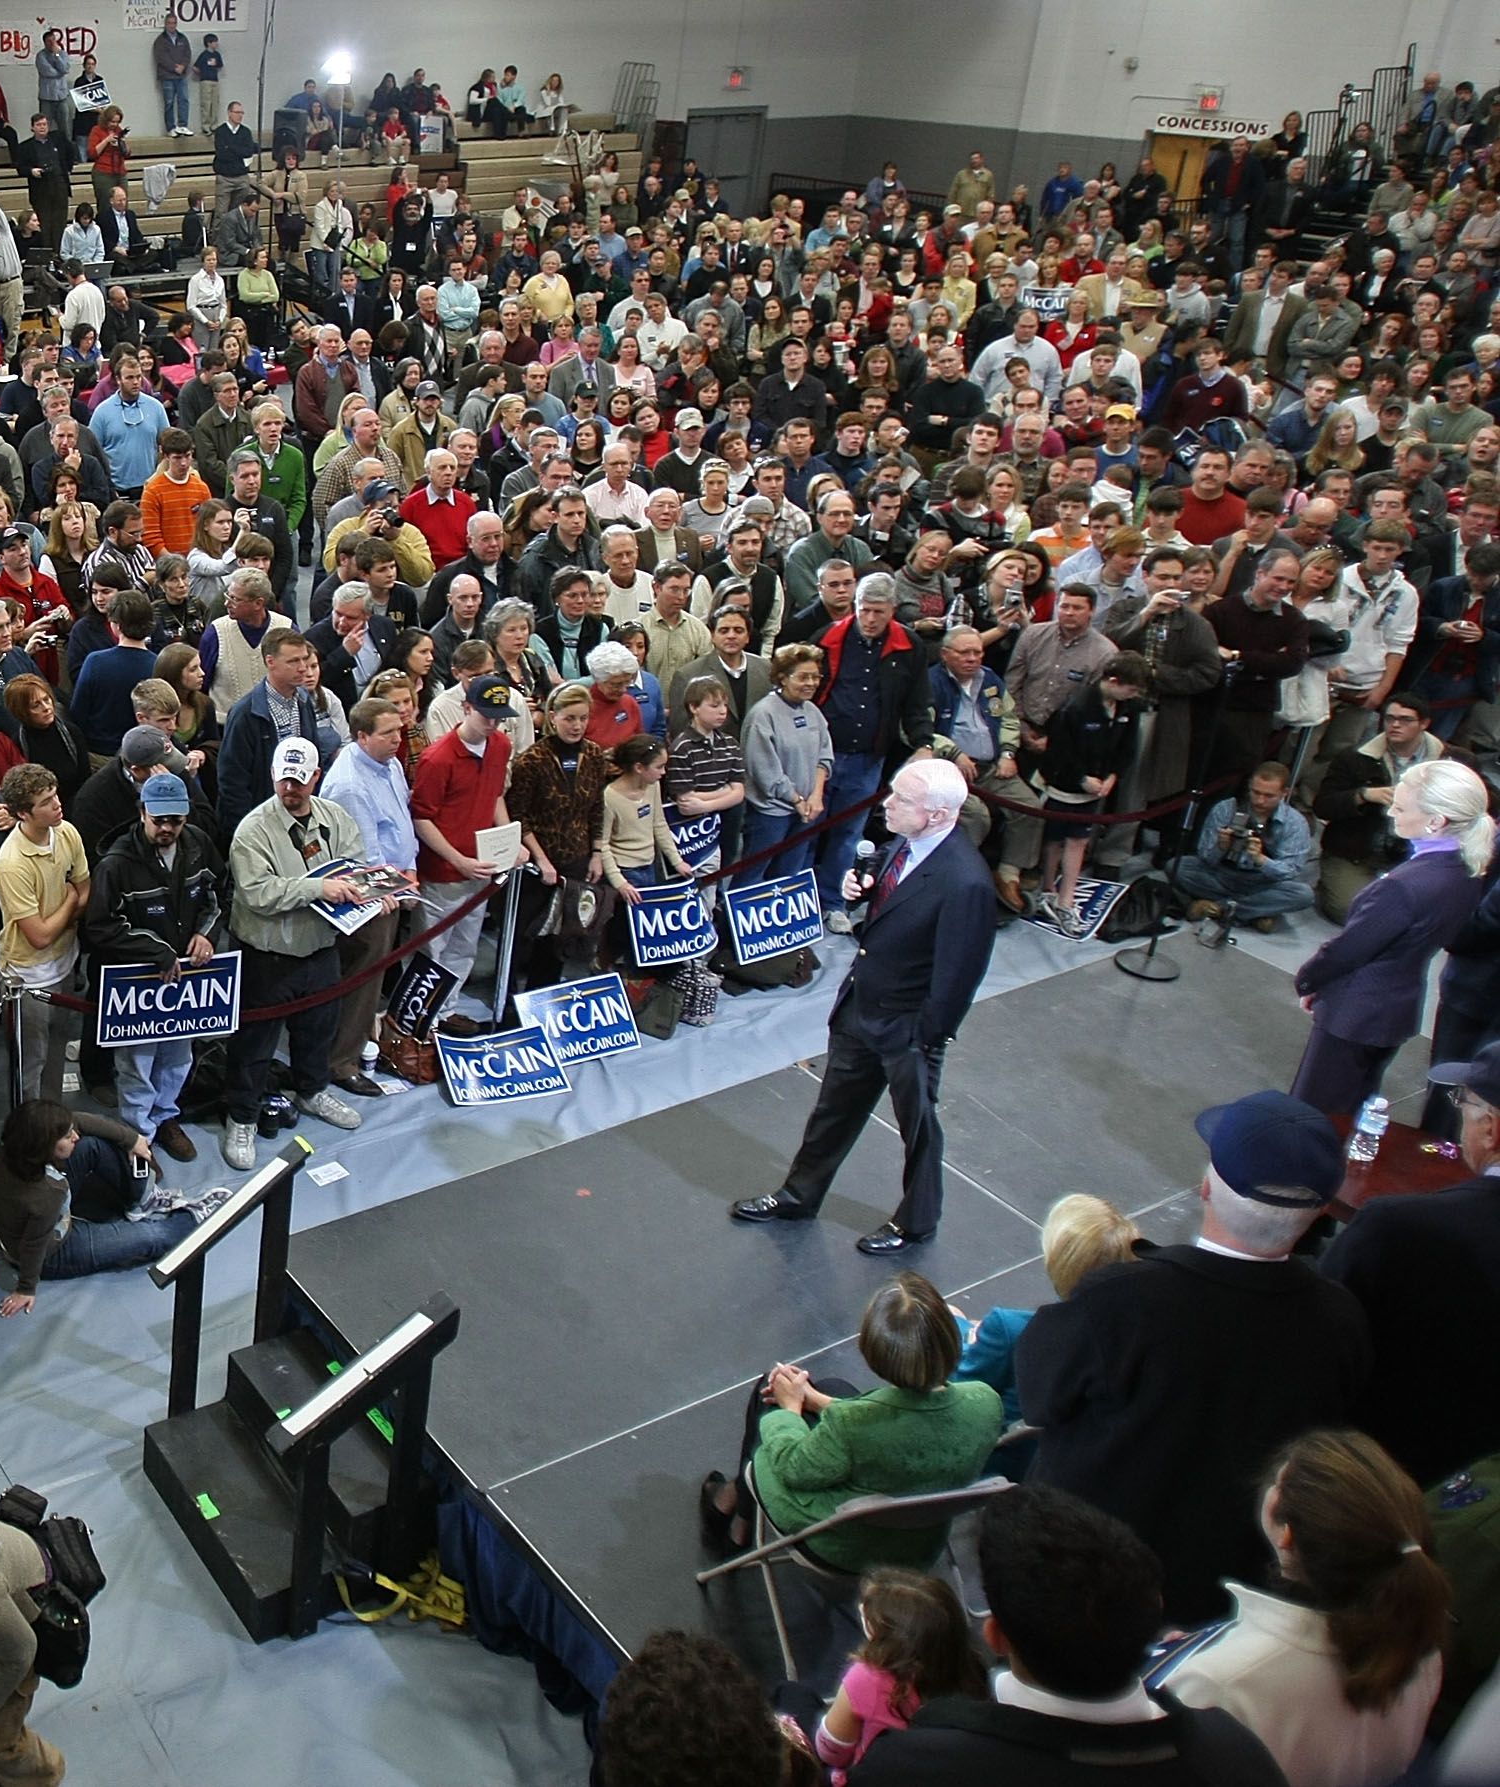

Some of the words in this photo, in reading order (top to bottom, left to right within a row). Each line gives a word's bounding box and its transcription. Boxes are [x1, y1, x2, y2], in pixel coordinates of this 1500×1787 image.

[1157, 115, 1268, 135] CONCESSIONS
[736, 889, 818, 937] McCAIN
[106, 976, 233, 1016] McCAIN
[531, 993, 630, 1038] McCAIN
[445, 1042, 555, 1081] McCAIN
